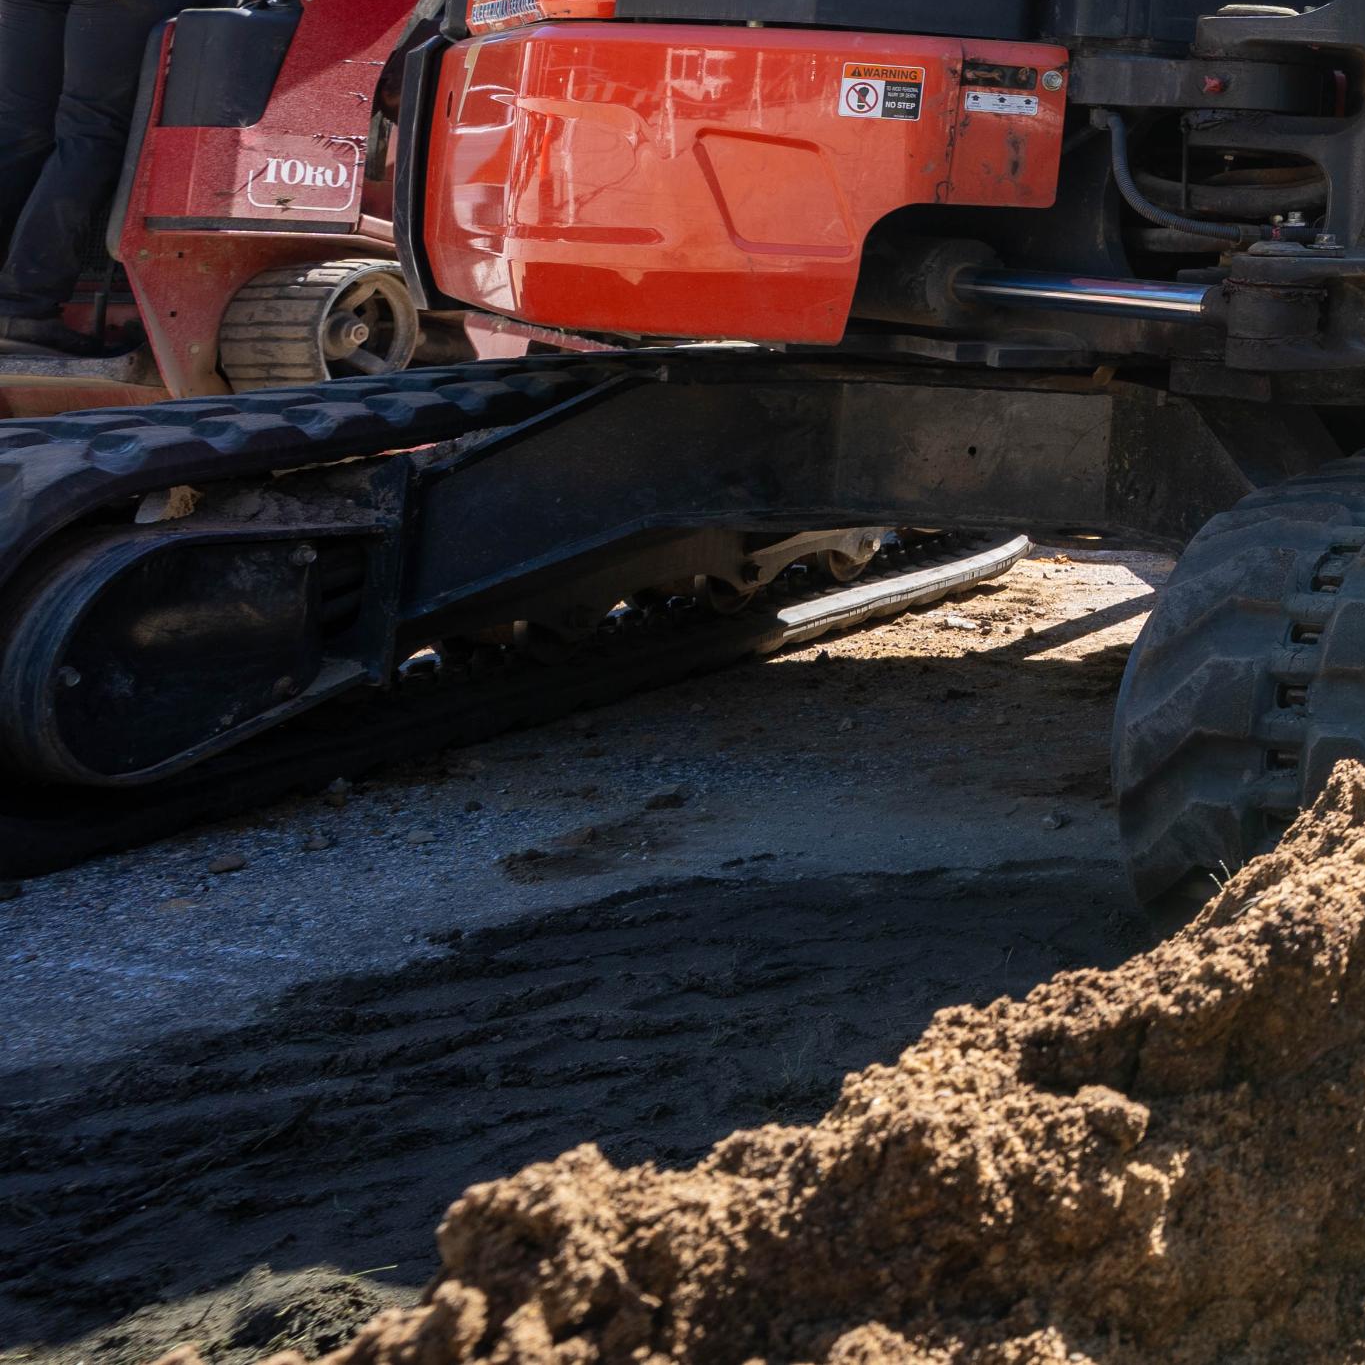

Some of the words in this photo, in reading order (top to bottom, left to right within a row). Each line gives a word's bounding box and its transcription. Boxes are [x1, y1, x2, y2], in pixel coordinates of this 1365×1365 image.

[863, 66, 918, 81] WARNING
[897, 102, 916, 110] STEP
[262, 157, 348, 188] TORO
